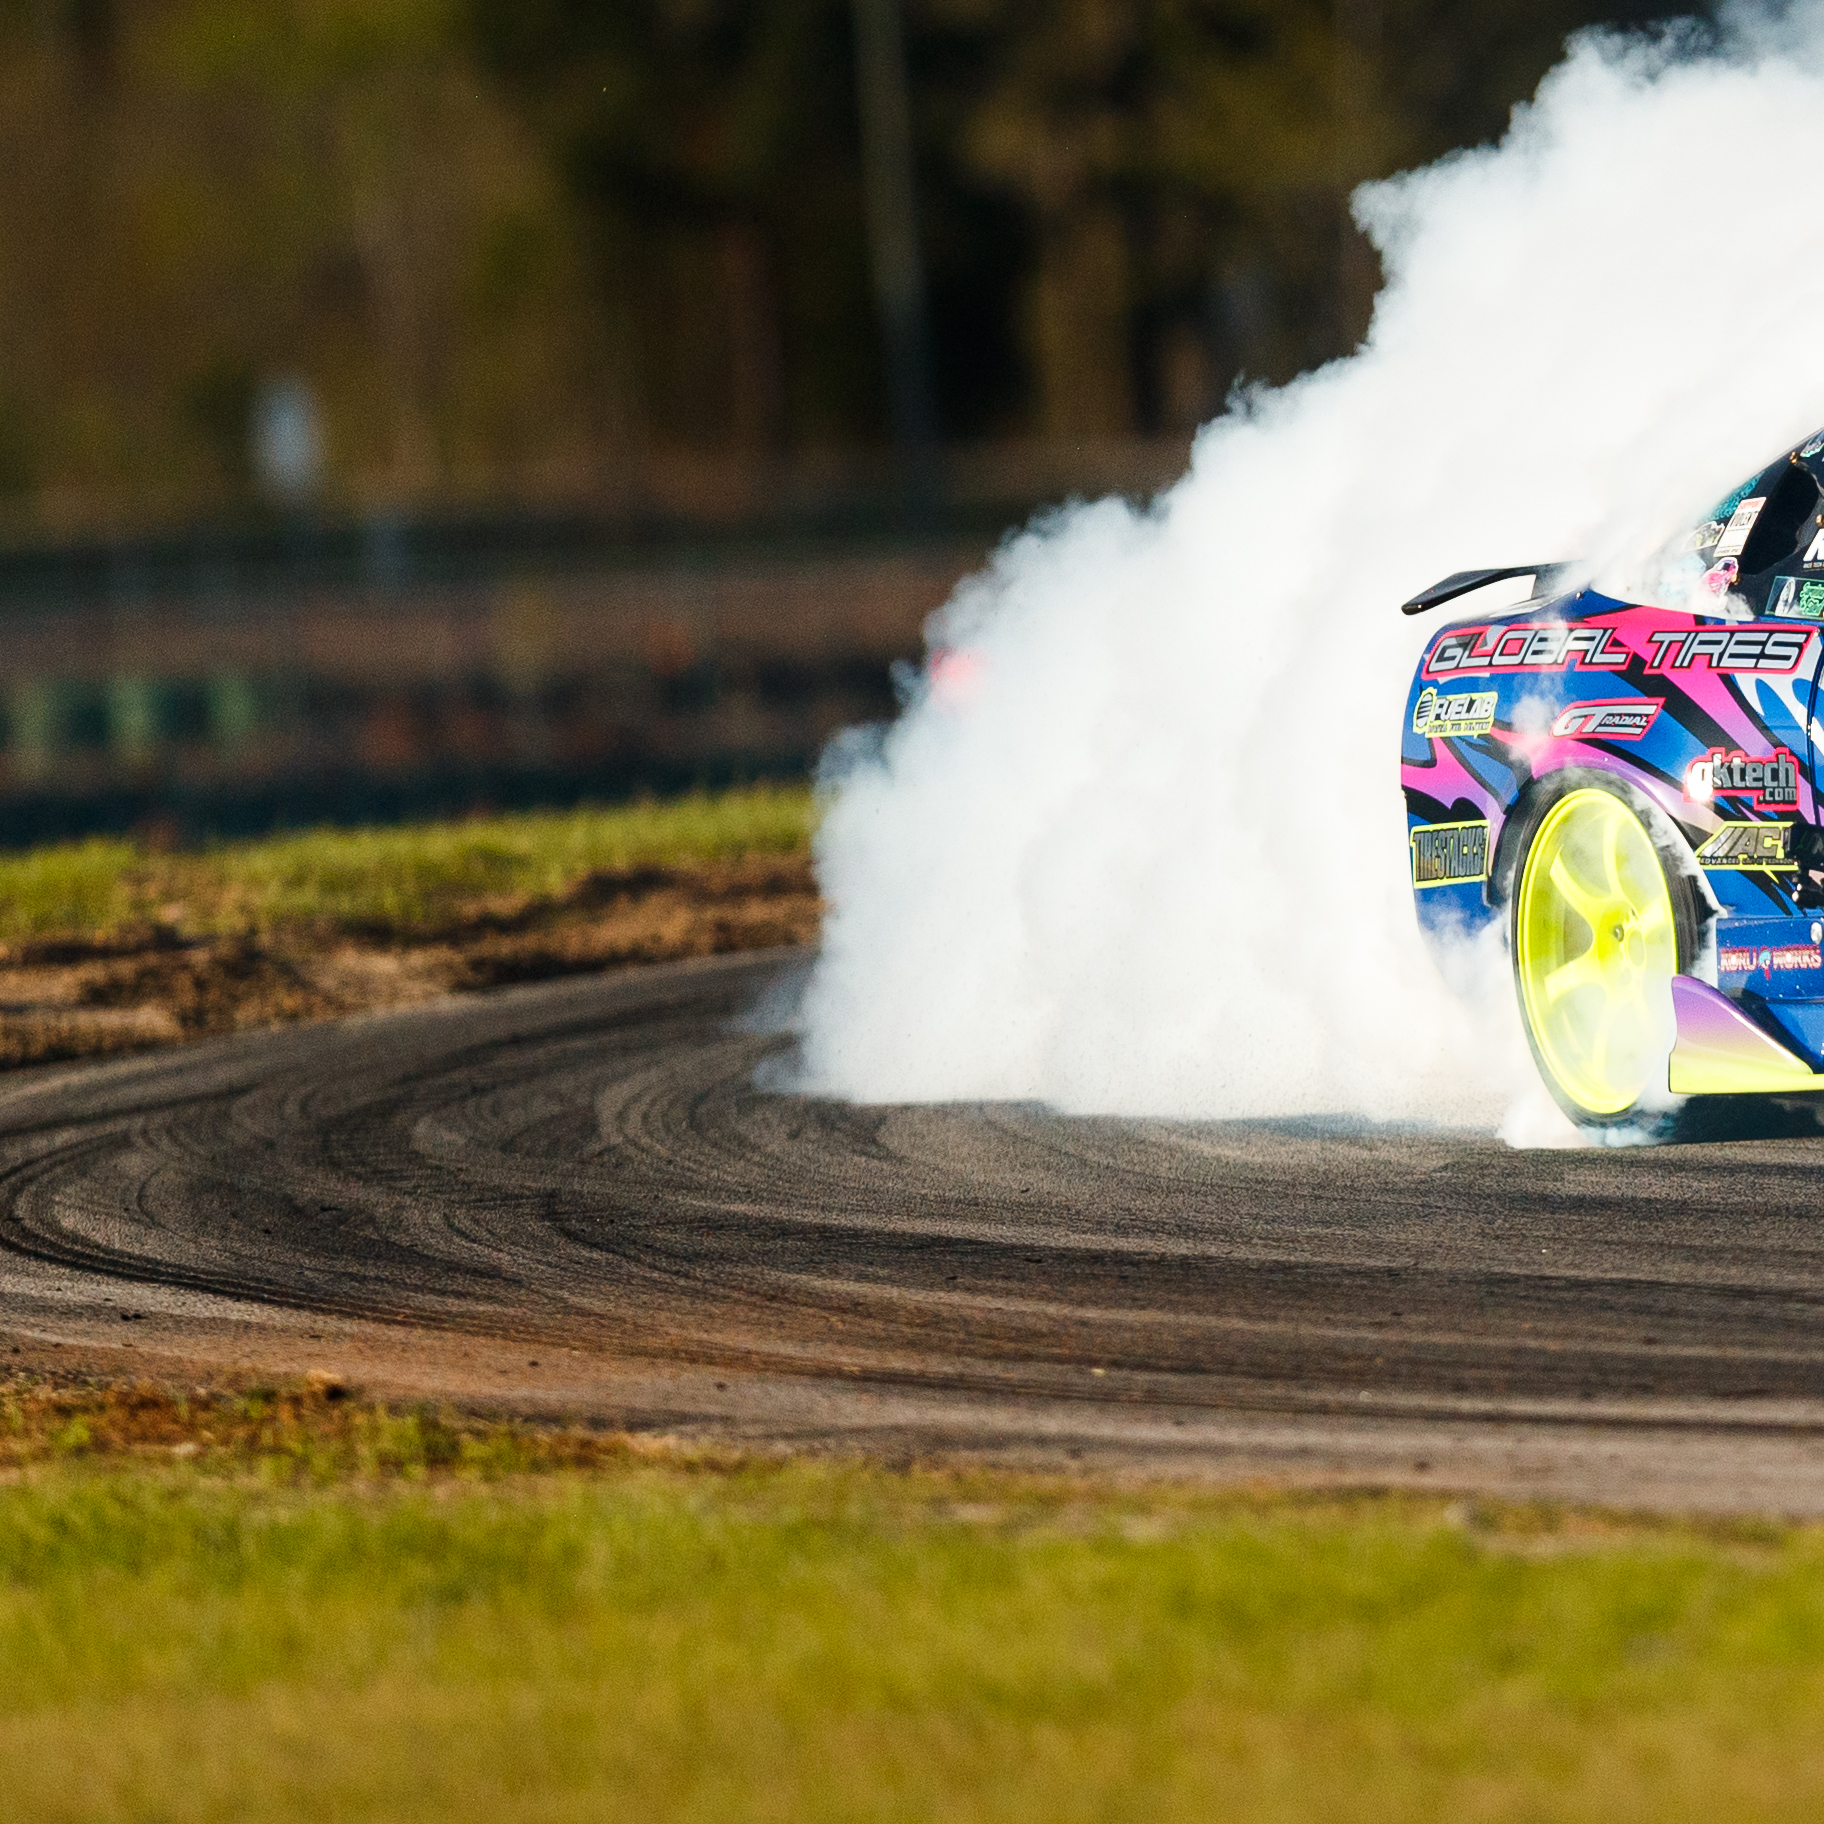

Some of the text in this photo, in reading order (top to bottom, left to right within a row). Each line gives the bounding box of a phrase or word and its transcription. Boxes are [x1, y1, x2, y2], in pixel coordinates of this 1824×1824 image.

[1429, 628, 1808, 673] GLOBAL TIRES
[1430, 695, 1495, 722] FUELAB
[1552, 705, 1648, 736] GT RADIAL
[1759, 787, 1797, 801] .com
